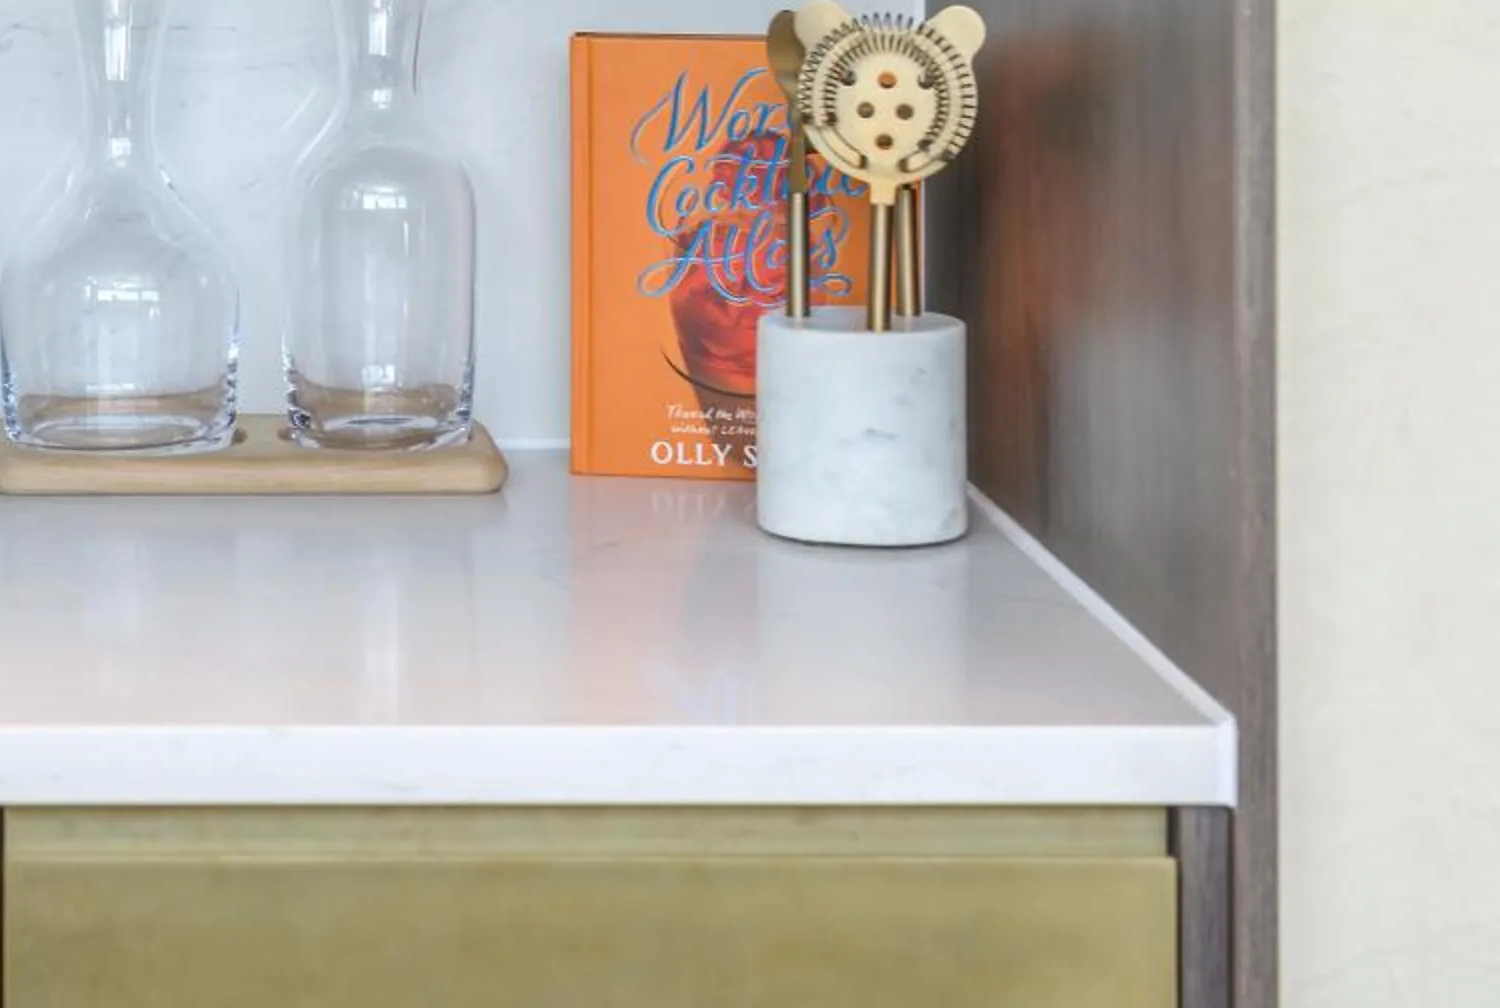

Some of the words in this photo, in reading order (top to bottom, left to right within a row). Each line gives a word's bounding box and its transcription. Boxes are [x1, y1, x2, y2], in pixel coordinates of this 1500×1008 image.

[630, 66, 794, 165] Wor
[650, 440, 733, 468] OLLY
[743, 444, 757, 469] S
